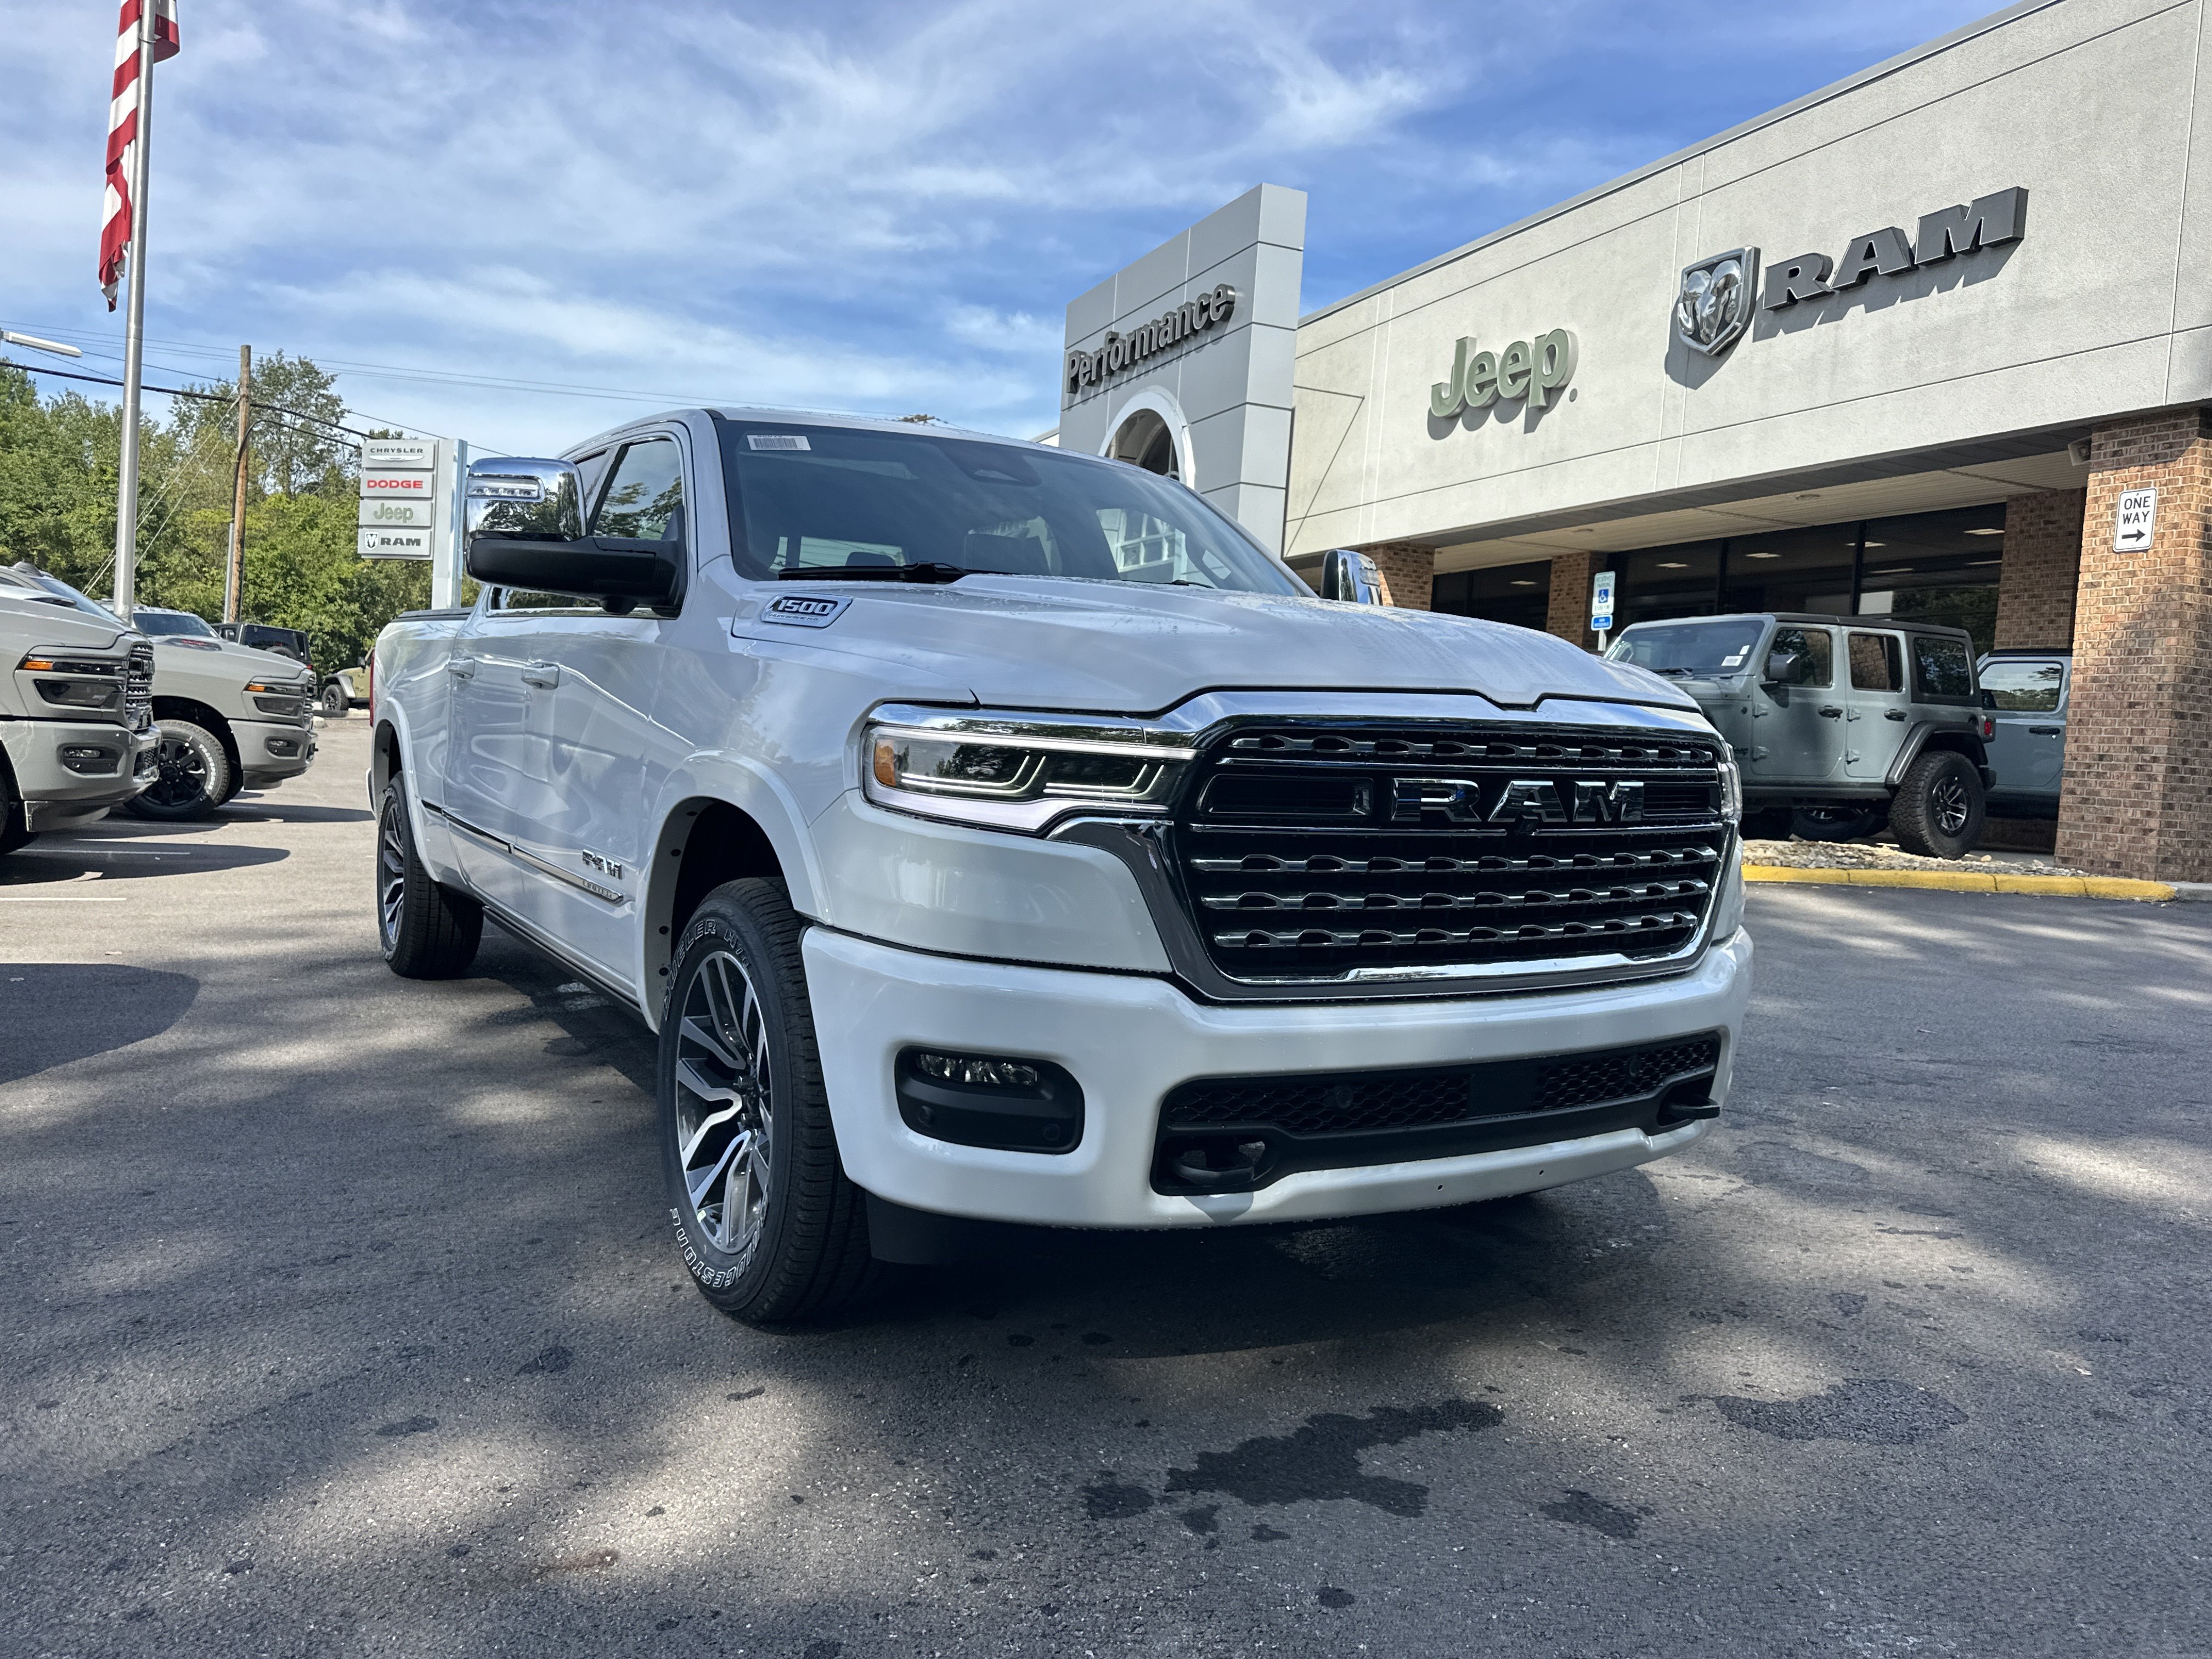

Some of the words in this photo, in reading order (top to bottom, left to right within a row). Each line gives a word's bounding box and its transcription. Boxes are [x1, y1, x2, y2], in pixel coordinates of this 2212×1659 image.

[1763, 186, 2029, 311] RAM
[1066, 283, 1235, 393] Performance
[1430, 328, 1578, 418] Jeep
[367, 479, 424, 489] DODGE
[374, 503, 414, 523] Jeep
[2123, 511, 2149, 524] WAY
[2124, 496, 2151, 510] ONE
[380, 537, 421, 546] RAM
[777, 599, 834, 614] 1500
[1391, 777, 1645, 822] RAM
[663, 919, 716, 1021] DUELER
[669, 1184, 769, 1288] BRIDGESTONE
